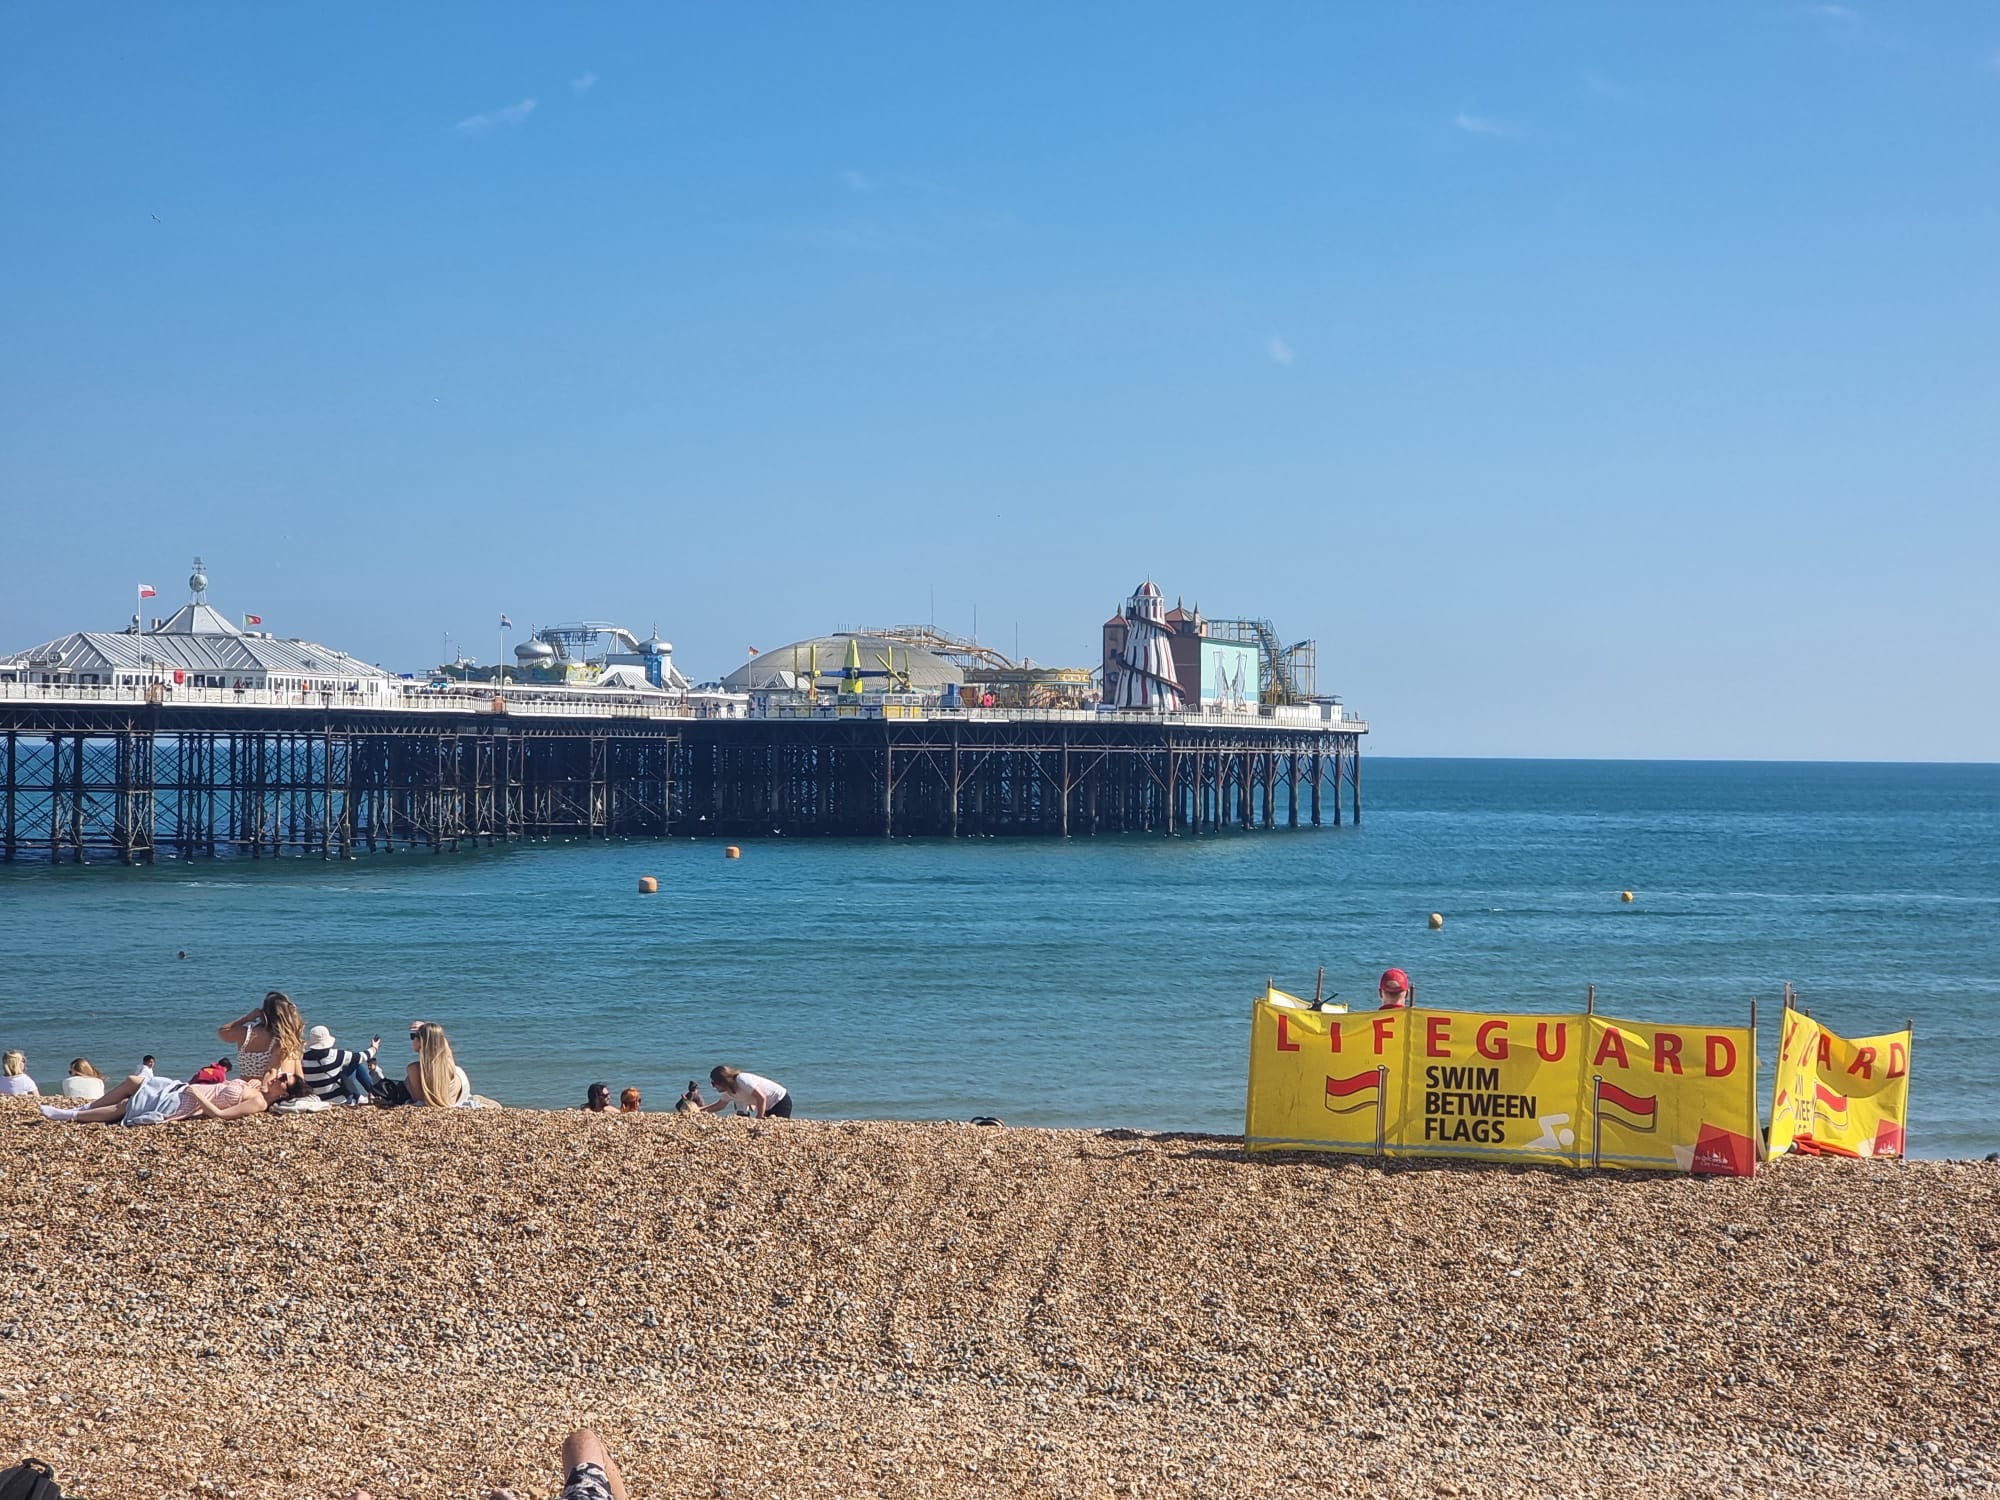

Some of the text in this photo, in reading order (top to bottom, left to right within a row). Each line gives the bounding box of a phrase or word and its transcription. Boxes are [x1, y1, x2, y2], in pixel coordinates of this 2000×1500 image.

[1277, 1014, 1737, 1077] LIFEGUARD
[1425, 1066, 1499, 1091] SWIM
[1425, 1091, 1537, 1119] BETWEEN
[1424, 1118, 1505, 1144] FLAGS
